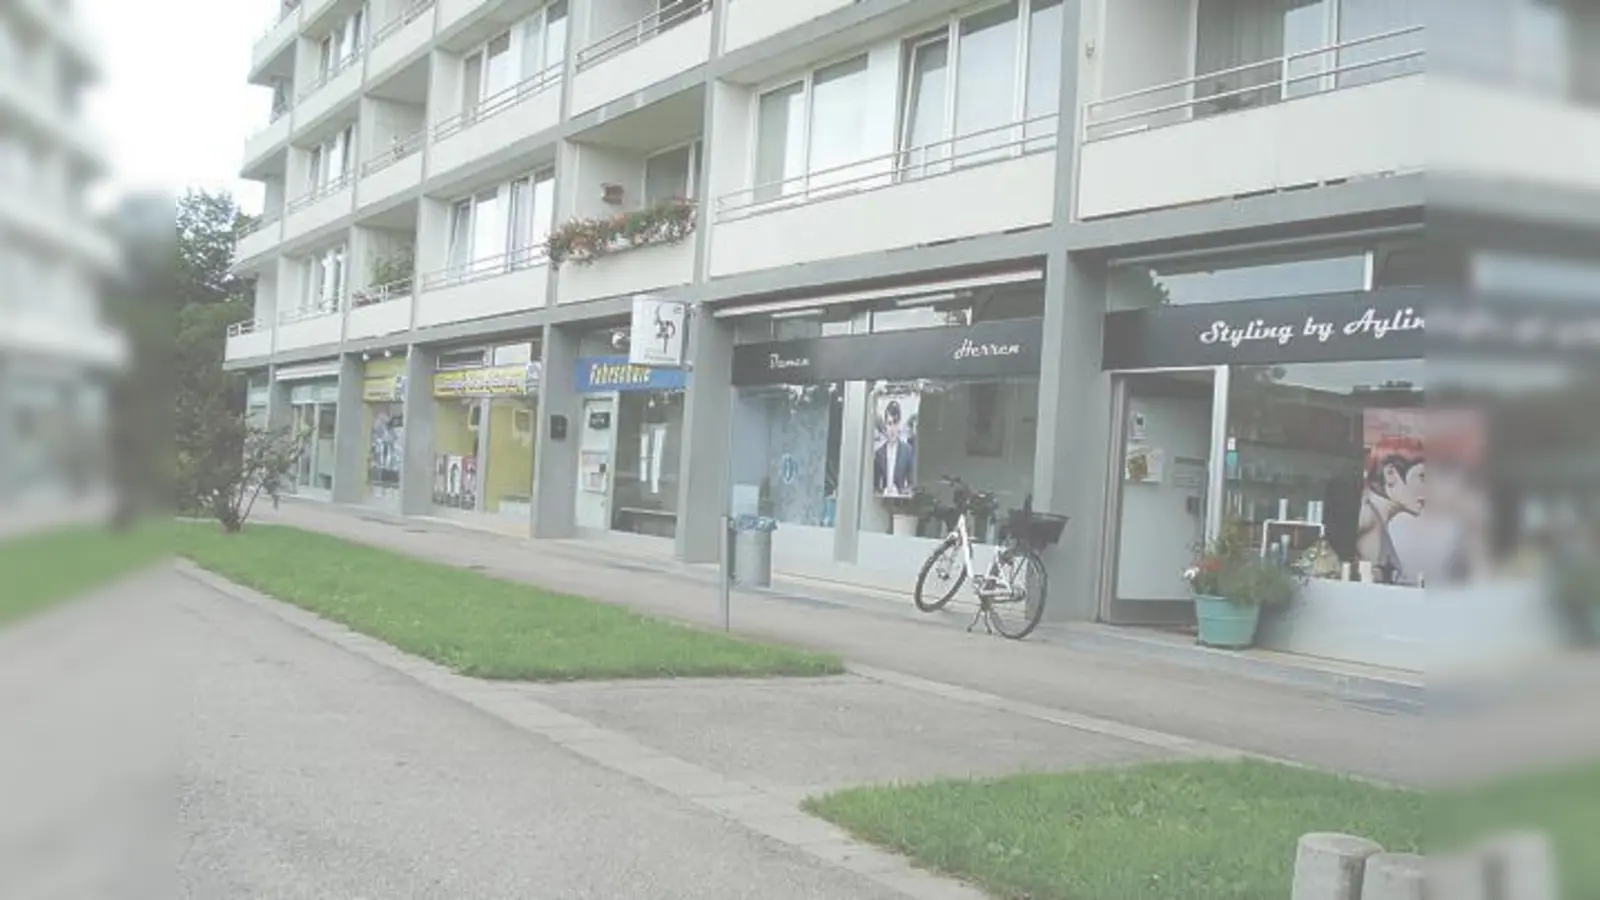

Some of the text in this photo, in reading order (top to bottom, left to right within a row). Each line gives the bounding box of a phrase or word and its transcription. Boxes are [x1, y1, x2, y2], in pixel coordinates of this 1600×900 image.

[1200, 320, 1293, 348] Styling
[1303, 316, 1334, 343] by
[953, 338, 1020, 360] Herren
[769, 352, 811, 369] Damen
